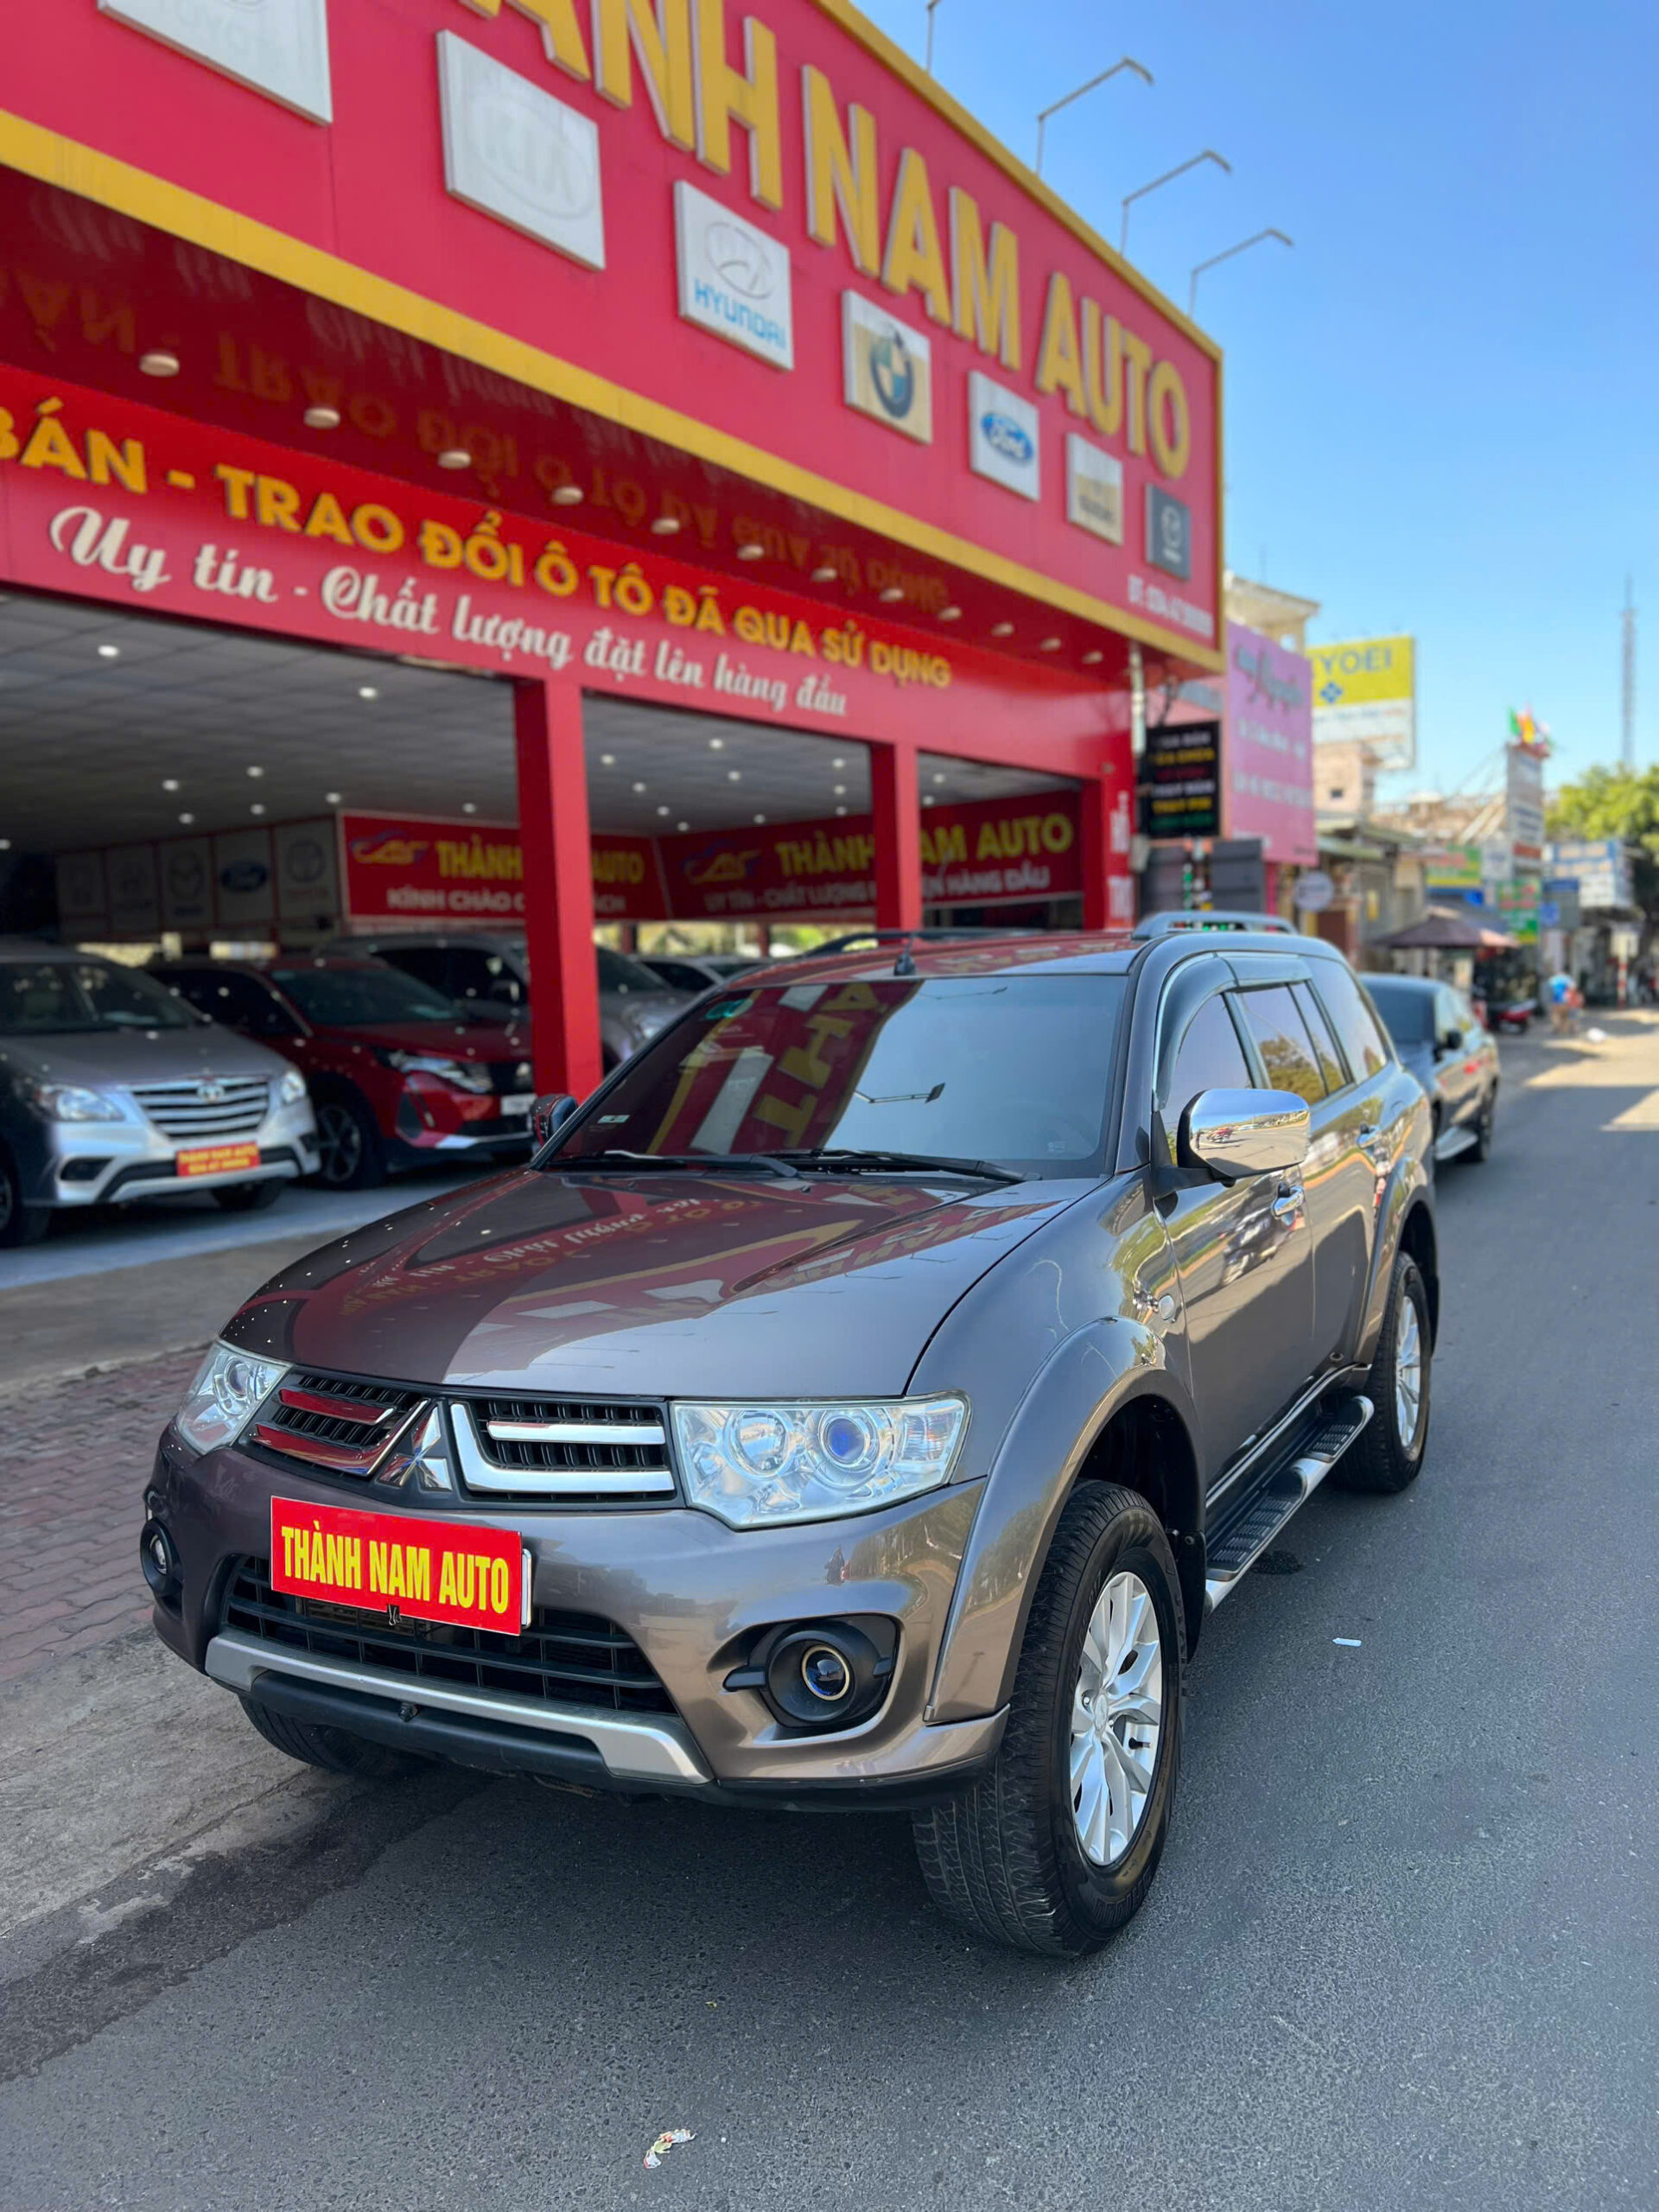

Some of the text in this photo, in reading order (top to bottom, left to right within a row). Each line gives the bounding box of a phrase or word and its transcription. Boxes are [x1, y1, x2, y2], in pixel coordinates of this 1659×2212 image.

[458, 0, 1191, 480] NH NAM AUTO
[694, 278, 786, 349] HYUNDAI
[50, 505, 171, 593] Uy
[193, 543, 278, 603] tín
[321, 565, 439, 634] Chất
[451, 595, 573, 671] lượng
[583, 627, 645, 682] đặt
[654, 639, 704, 689] lên
[713, 653, 787, 712] hàng
[795, 672, 846, 716] đầu
[214, 463, 404, 553] TRAO
[417, 510, 524, 588] ĐỔI
[535, 539, 579, 597] Ô
[588, 563, 654, 616] TÔ
[661, 584, 725, 637] ĐÃ
[733, 605, 816, 658] QUA
[822, 619, 864, 668] SỬ
[869, 640, 952, 690] DỤNG
[921, 824, 968, 863] AM
[976, 813, 1074, 861] AUTO
[281, 1520, 510, 1614] THÀNH NAM AUTO
